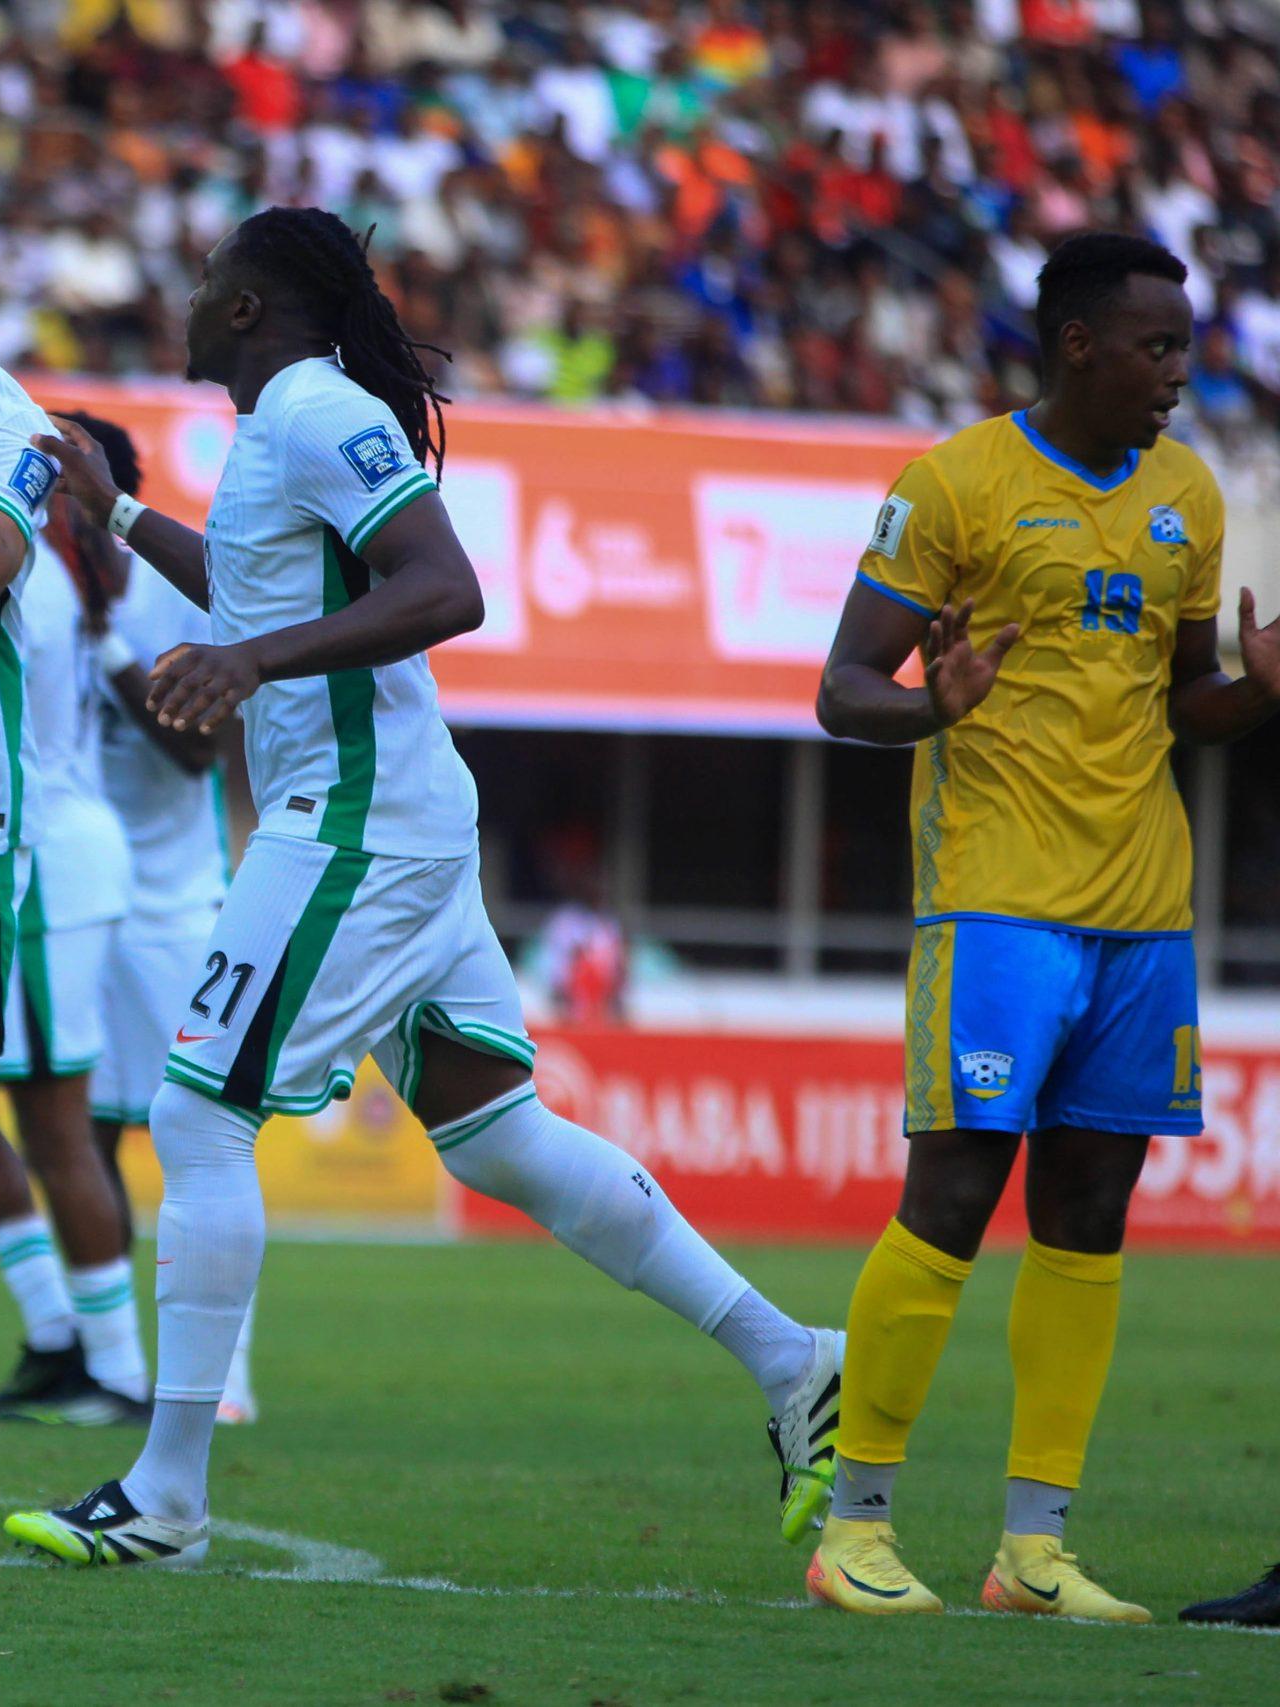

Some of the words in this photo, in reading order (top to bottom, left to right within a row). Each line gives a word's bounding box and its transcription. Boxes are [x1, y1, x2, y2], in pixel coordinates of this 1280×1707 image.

[358, 443, 388, 462] UNITES
[1082, 569, 1143, 634] 19
[190, 950, 256, 1029] 21
